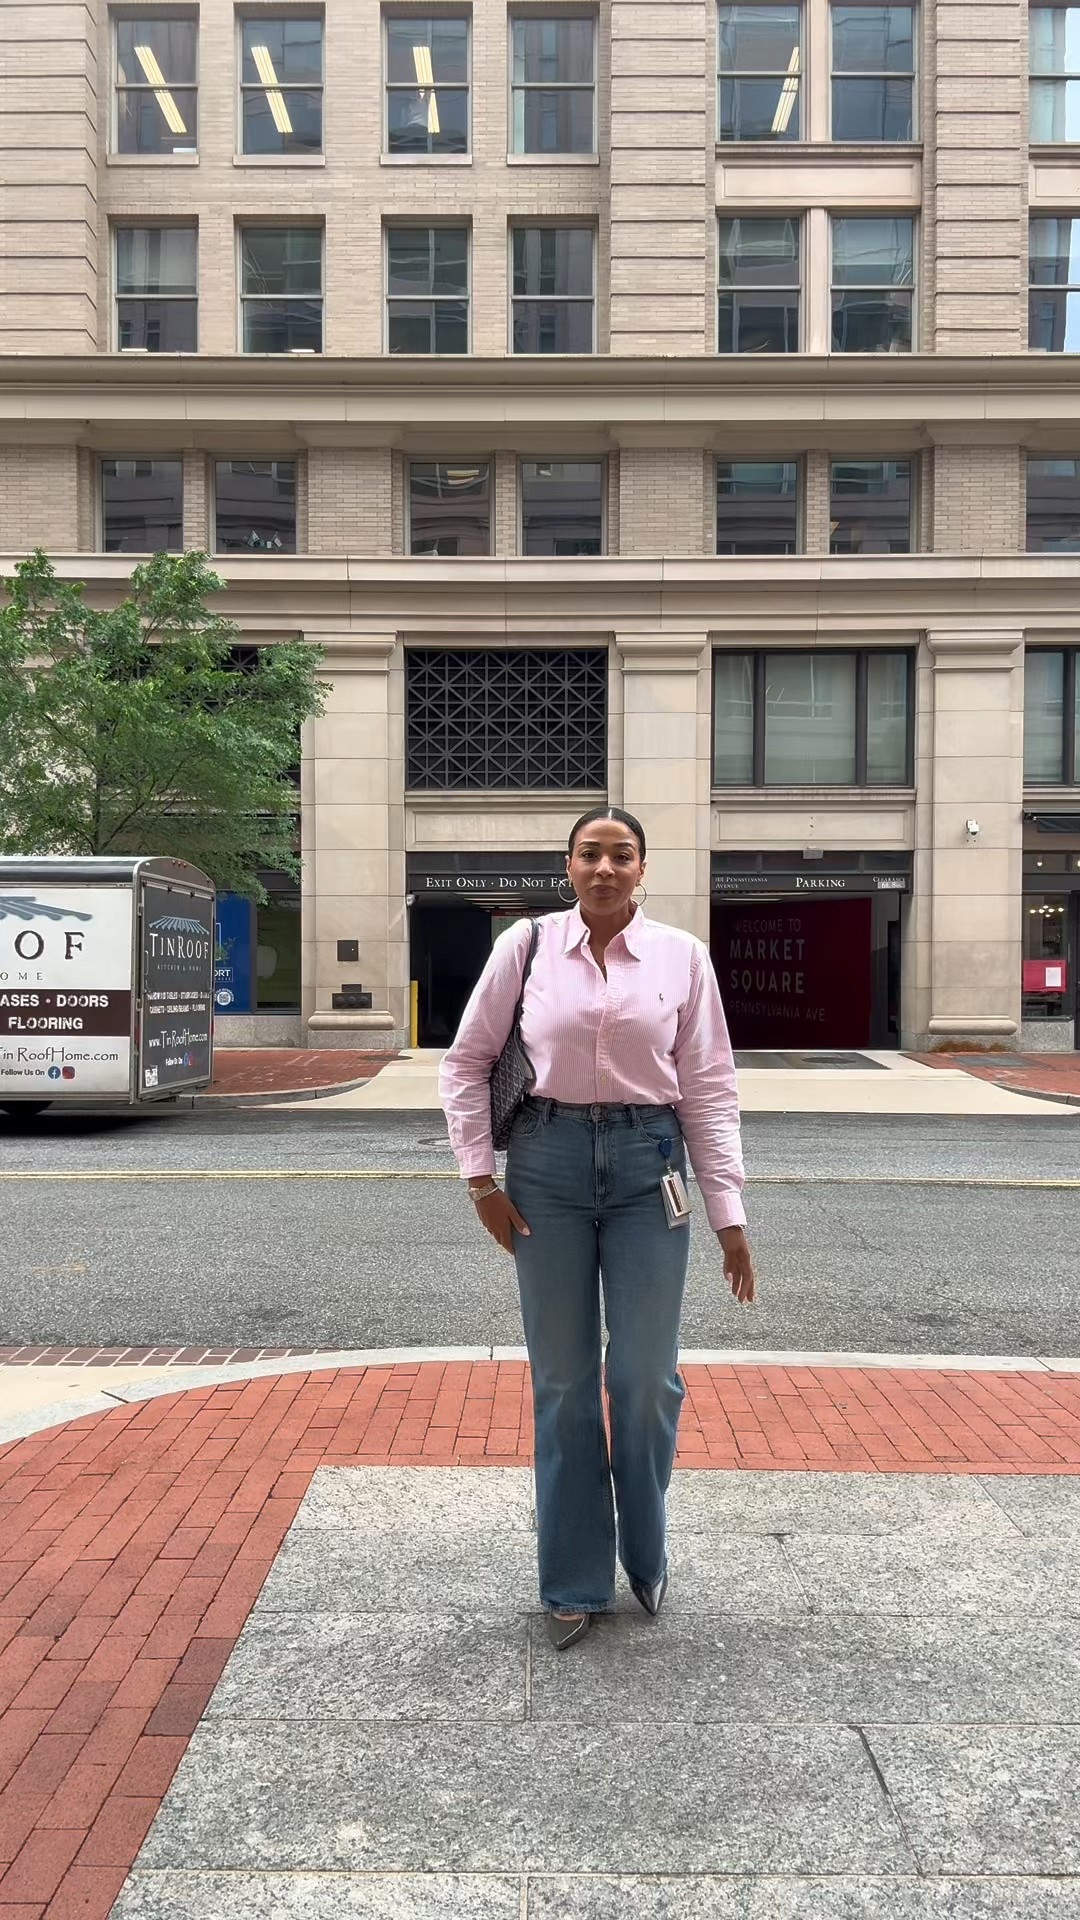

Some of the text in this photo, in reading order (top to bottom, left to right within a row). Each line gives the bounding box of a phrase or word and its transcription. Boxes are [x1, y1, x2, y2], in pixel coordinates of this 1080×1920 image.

[426, 877, 452, 888] EXIT
[456, 877, 486, 888] ONLY
[499, 877, 517, 888] DO
[521, 877, 545, 888] NOT
[795, 877, 845, 888] PARKING
[734, 919, 801, 933] WELCOME TO
[730, 938, 805, 961] MARKET
[730, 969, 805, 994] SQUARE
[0, 994, 109, 1008] ASES DOORS
[806, 1008, 825, 1022] AVE
[8, 1016, 84, 1030] FLOORING
[1, 1068, 46, 1076] Follow Us On
